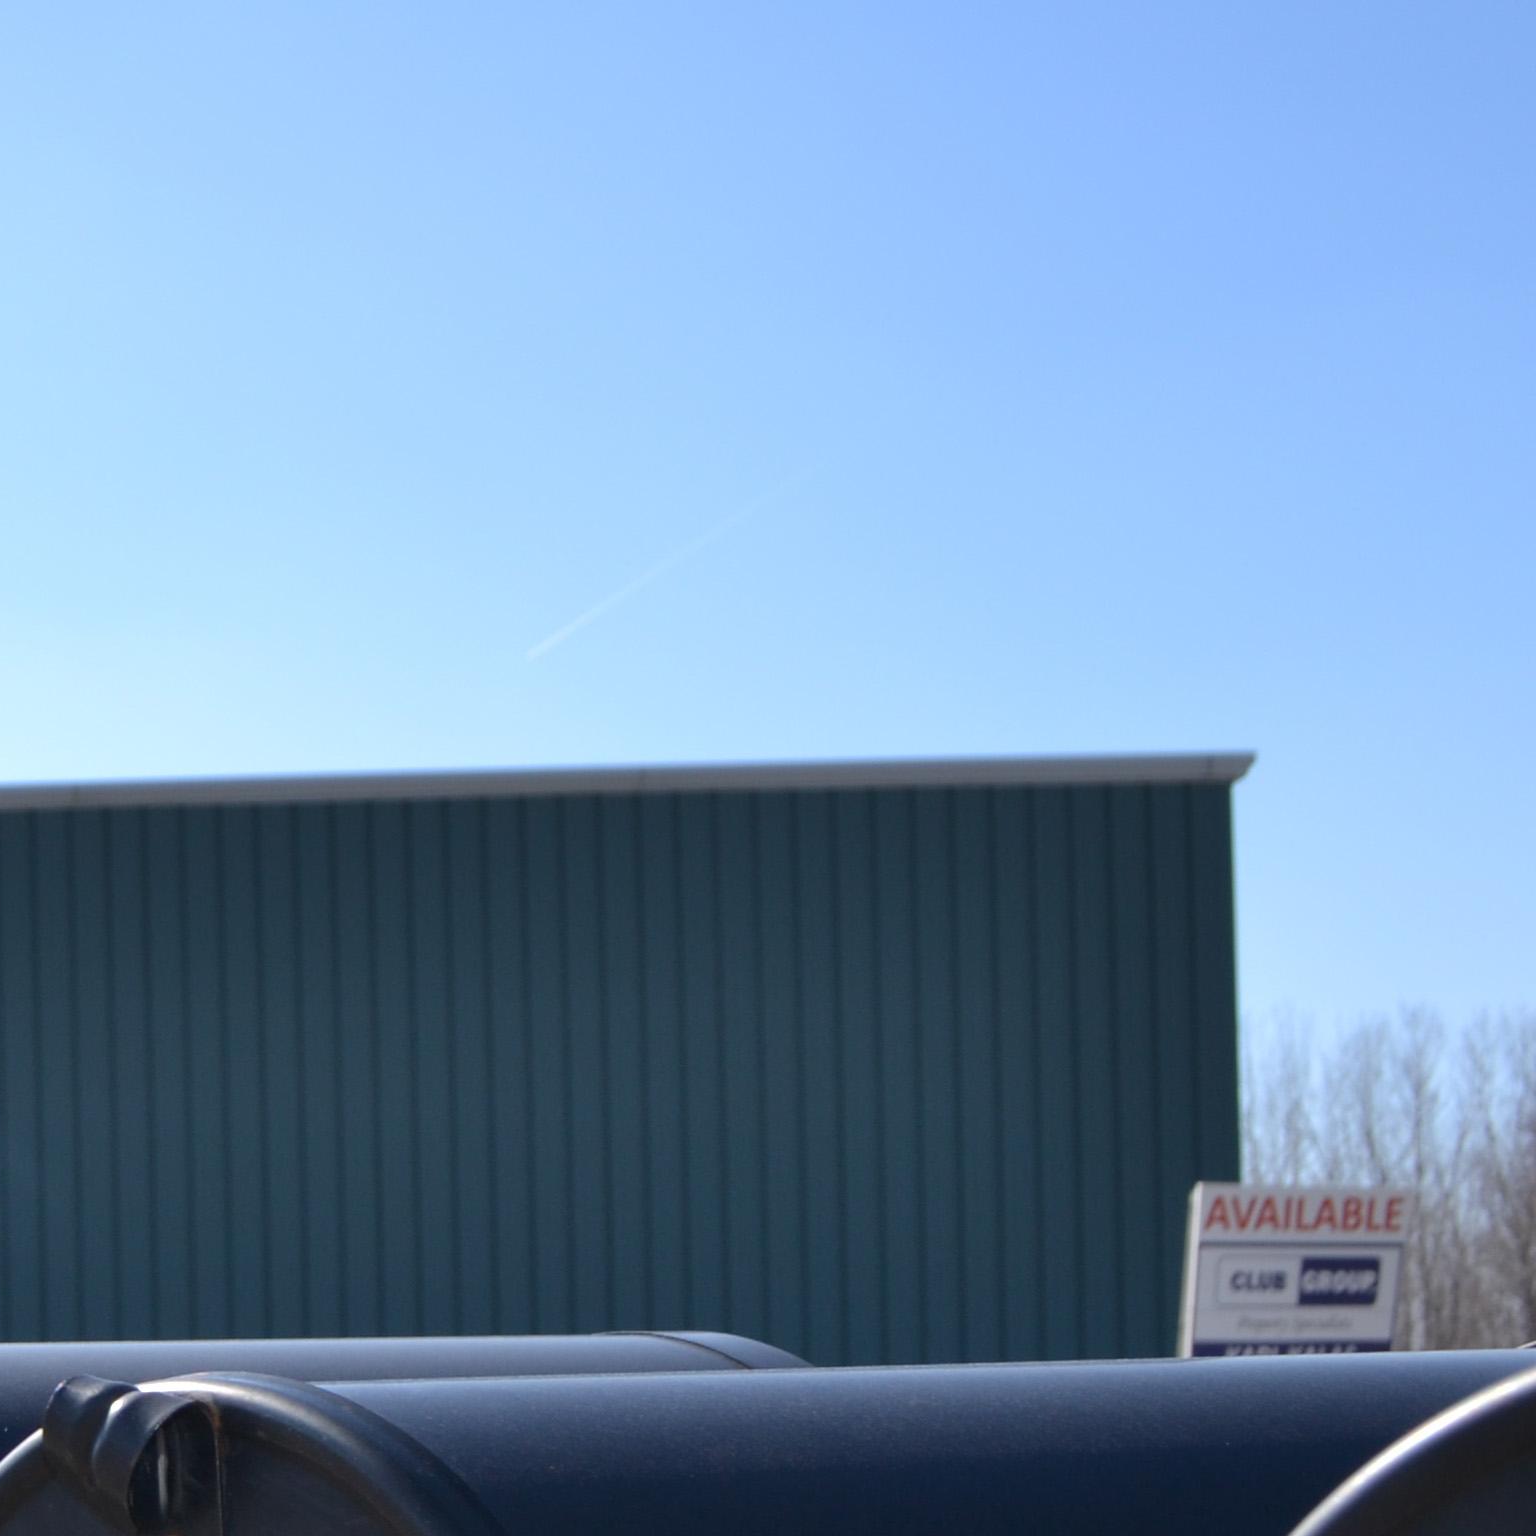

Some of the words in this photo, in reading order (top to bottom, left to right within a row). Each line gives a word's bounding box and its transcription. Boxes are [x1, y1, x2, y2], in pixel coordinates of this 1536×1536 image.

[1203, 1193, 1406, 1234] AVAILABLE
[1231, 1270, 1287, 1291] CLUB
[1302, 1267, 1378, 1296] GROUP
